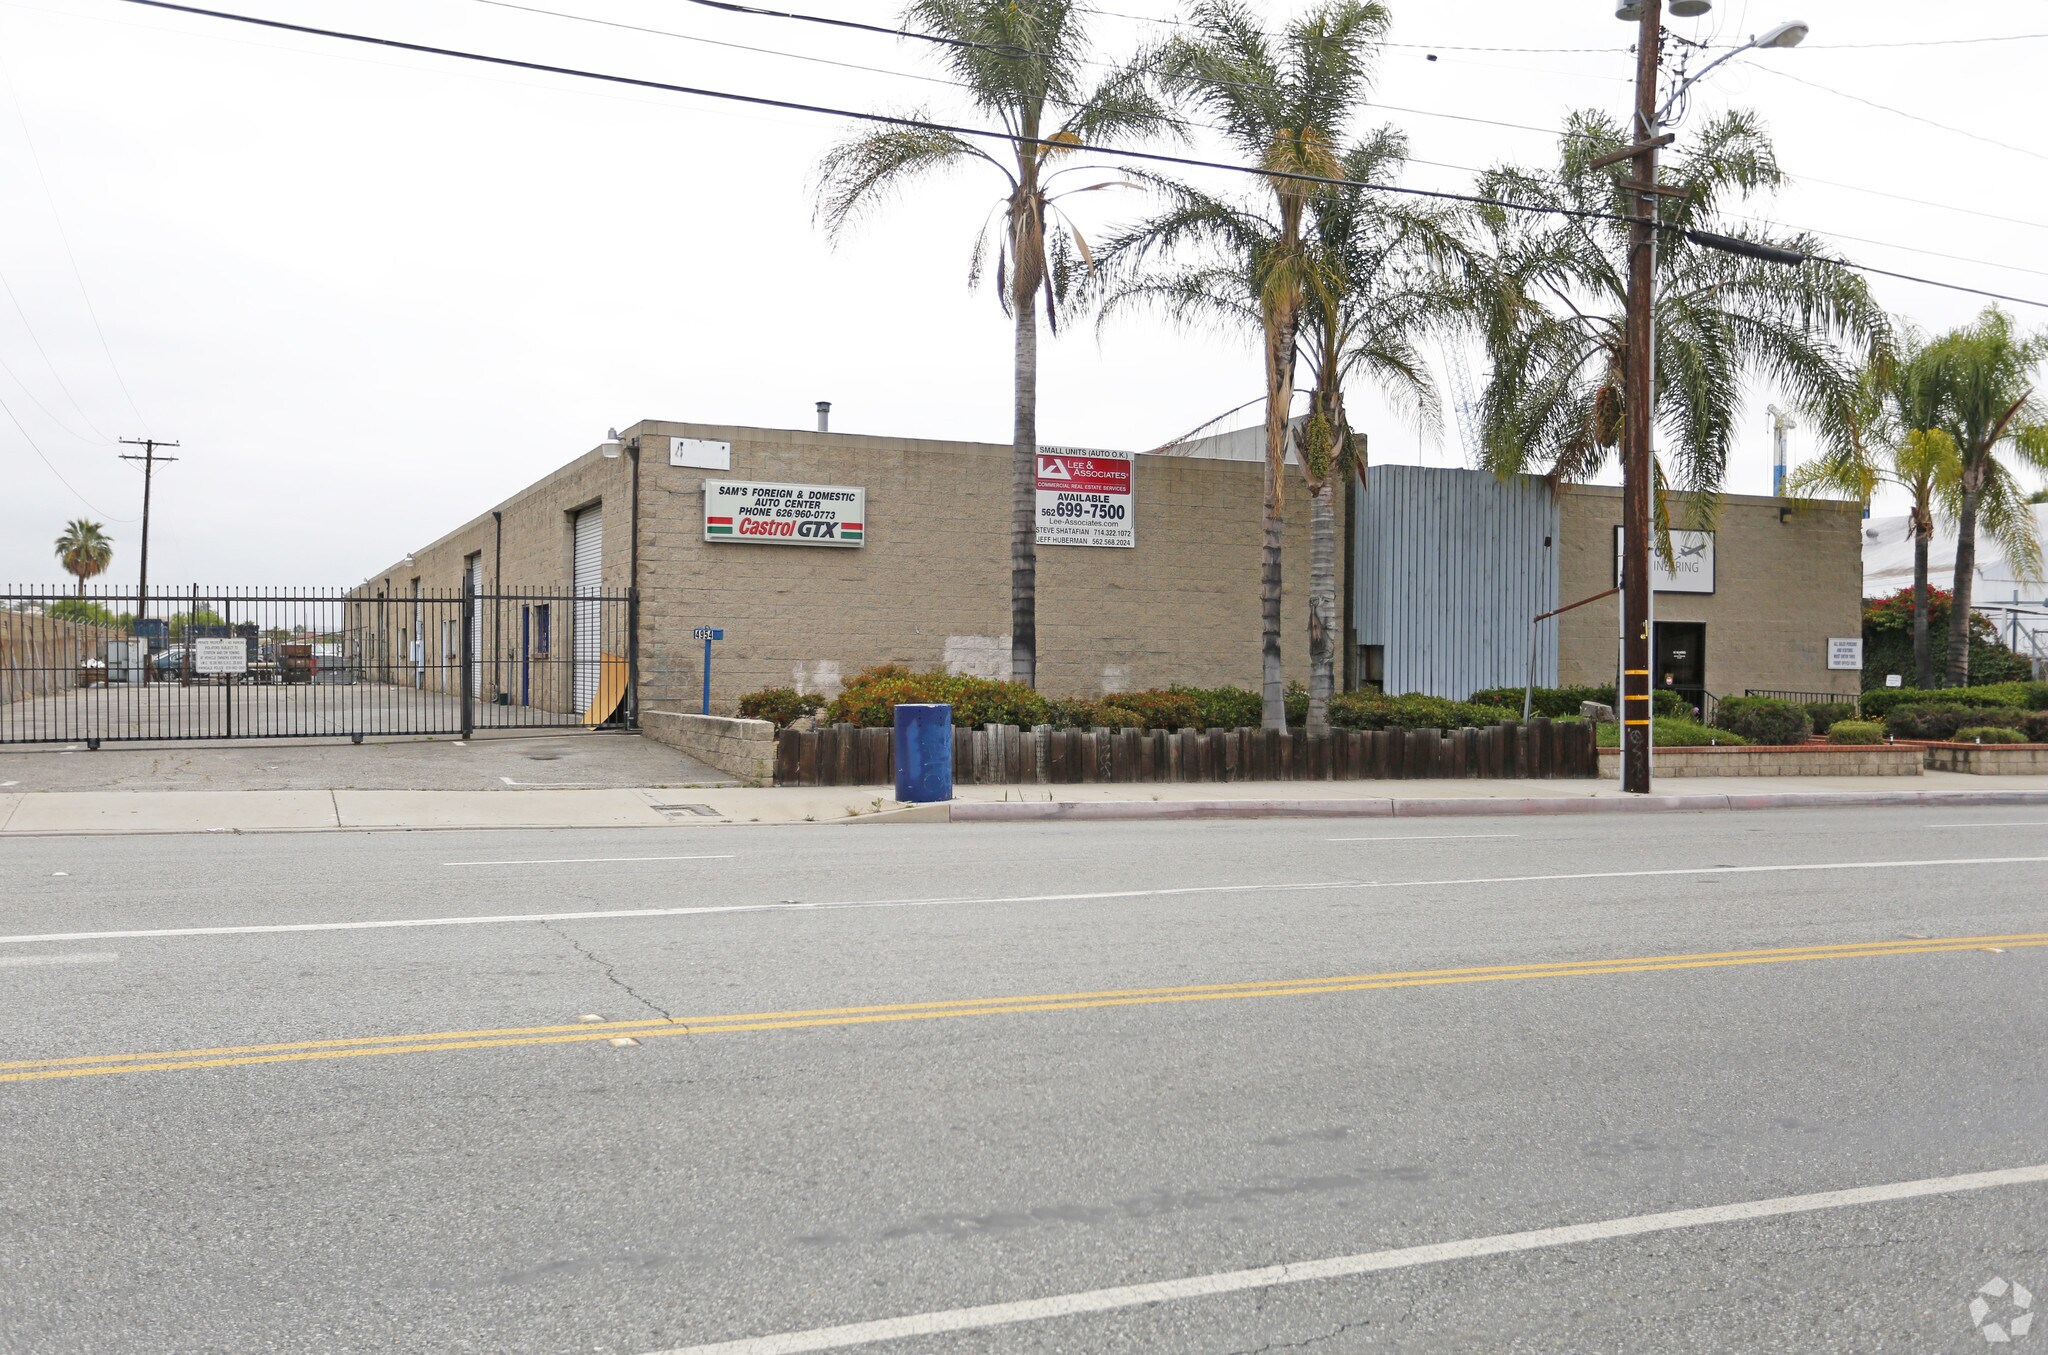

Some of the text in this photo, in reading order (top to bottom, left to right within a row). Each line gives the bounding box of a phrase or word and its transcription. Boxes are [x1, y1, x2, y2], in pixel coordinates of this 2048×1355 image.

[1066, 448, 1087, 456] UNITS
[1112, 451, 1128, 459] O.K.)
[1086, 460, 1094, 469] &
[719, 487, 856, 502] SAM'S FOREIGN & DOMESTIC
[1057, 493, 1110, 503] AVAILABLE
[754, 498, 821, 510] AUTO CENTER
[739, 507, 836, 519] PHONE 626/960-0773
[1041, 502, 1125, 520] 562 699-7500
[739, 517, 839, 538] Castrol GTX
[1049, 518, 1118, 527] Lee-Associates.com
[1056, 527, 1089, 535] SHATAFIAN
[1094, 529, 1131, 537] 714.322.1072
[695, 630, 713, 639] 4954
